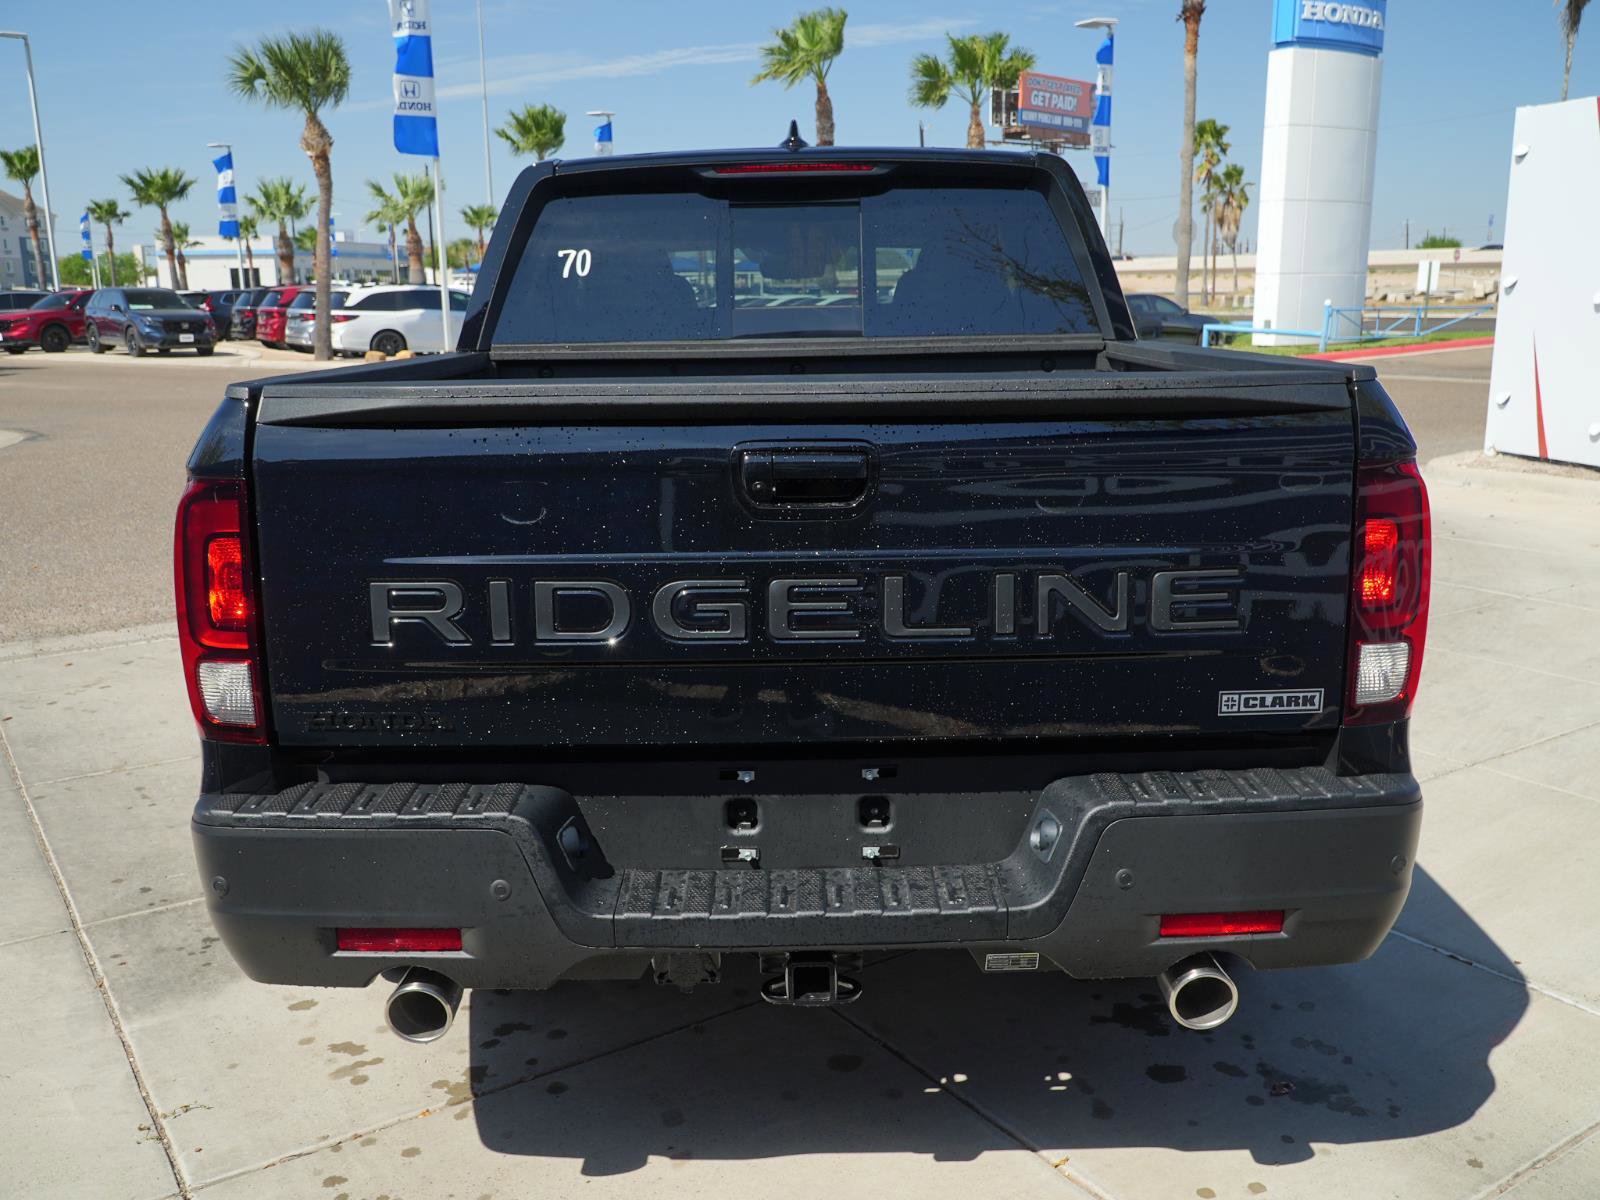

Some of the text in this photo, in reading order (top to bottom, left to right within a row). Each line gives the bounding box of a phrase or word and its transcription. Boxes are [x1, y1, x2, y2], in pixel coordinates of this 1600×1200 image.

[1301, 2, 1384, 28] HONDA
[1031, 90, 1077, 112] GET PAID!
[558, 249, 591, 278] 70
[369, 568, 1244, 646] RIDGELINE
[1243, 695, 1317, 709] CLARK
